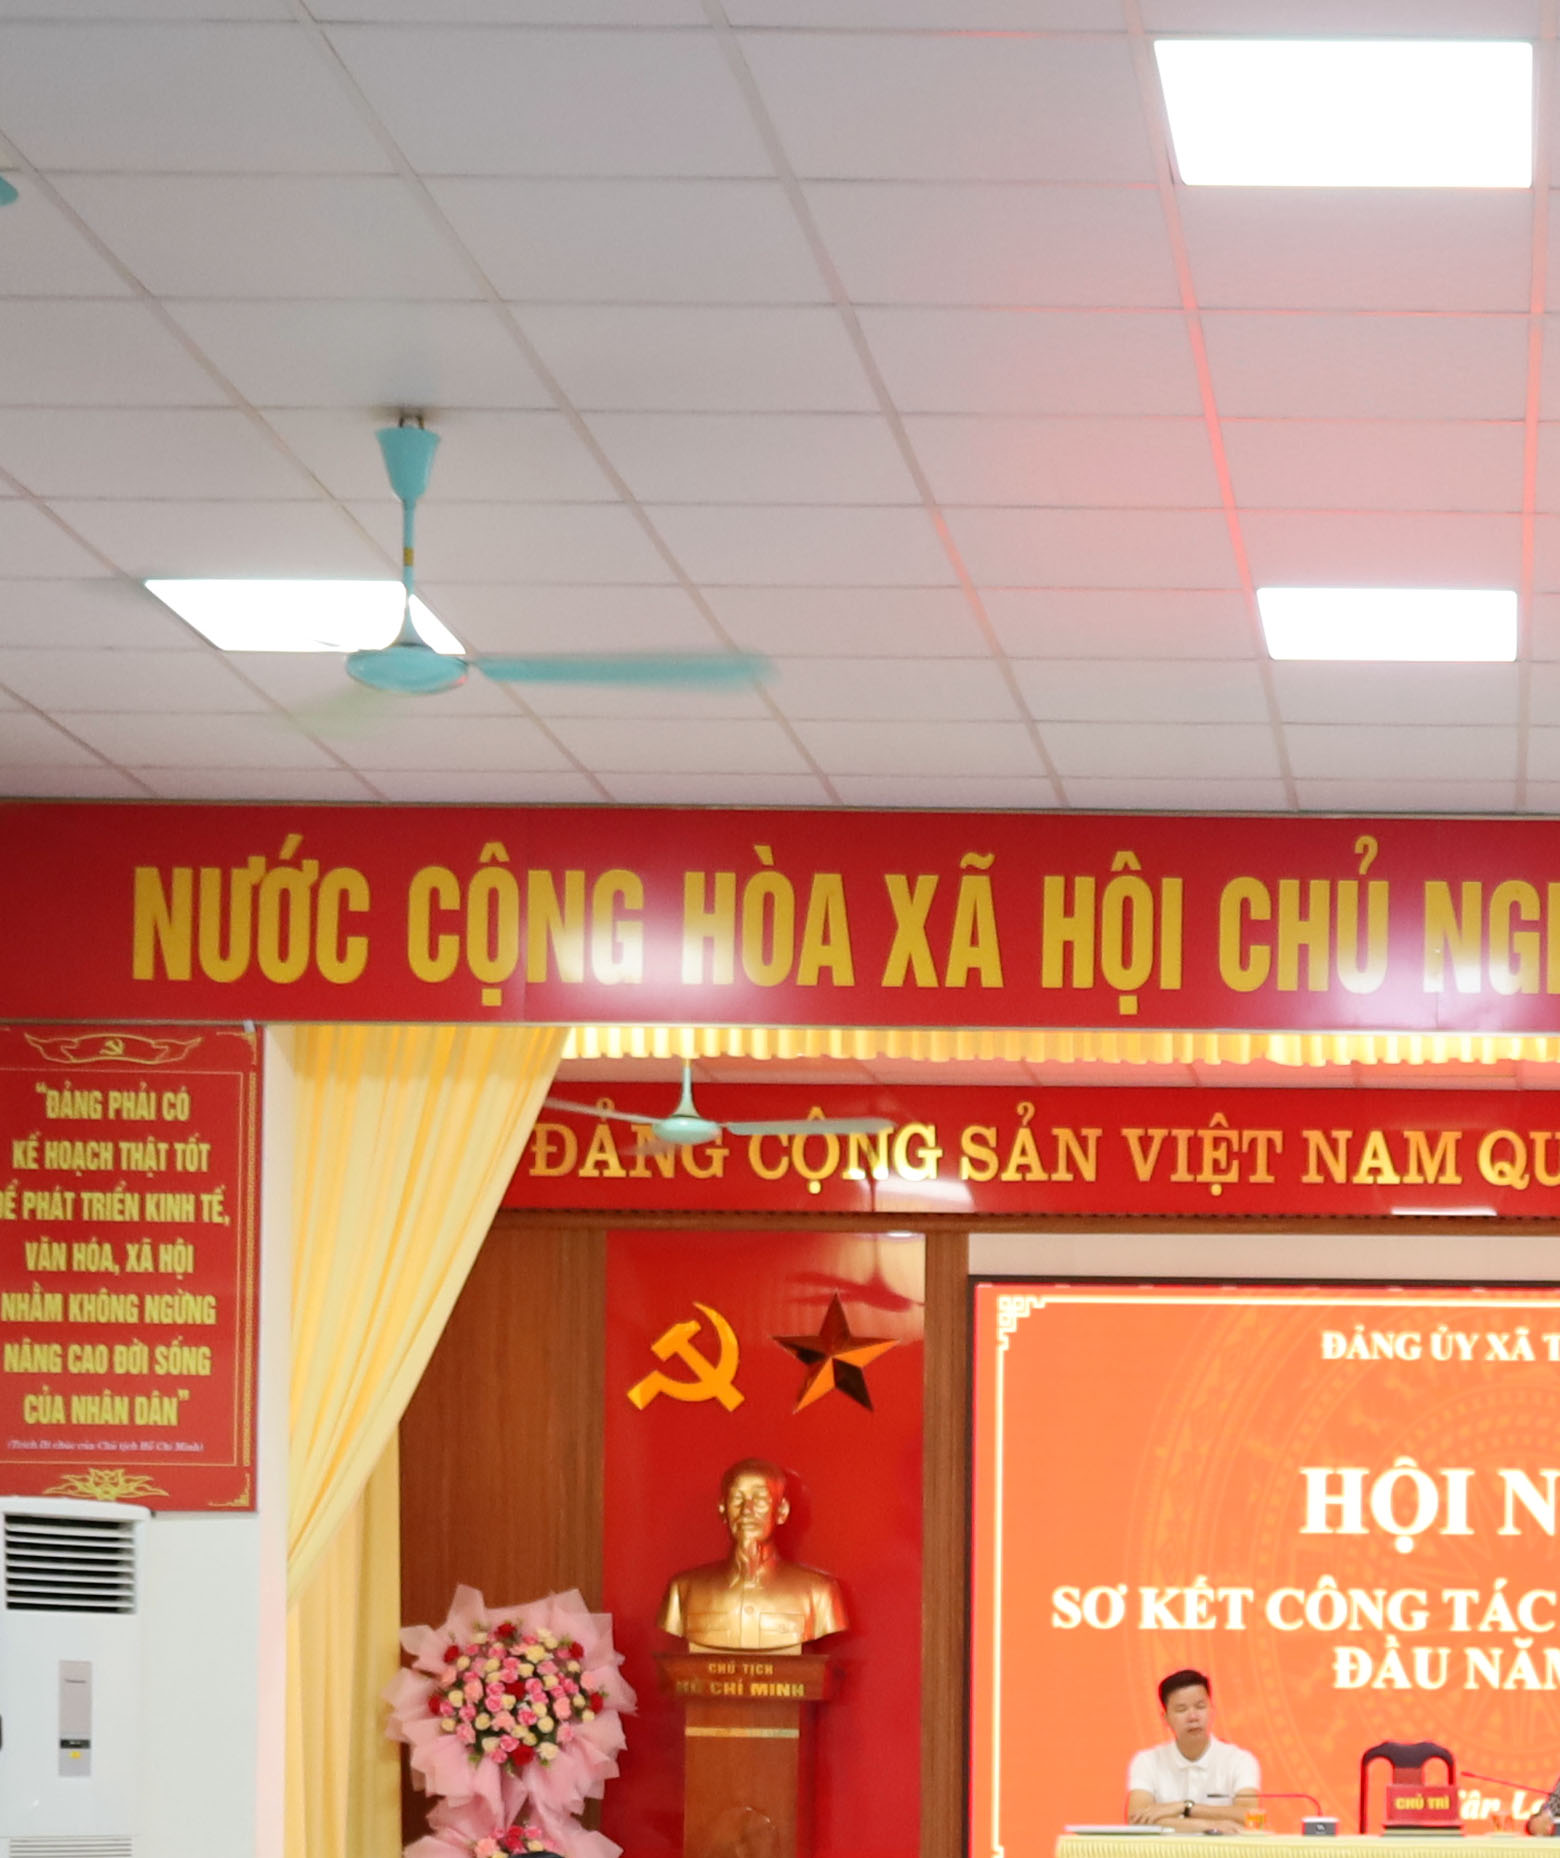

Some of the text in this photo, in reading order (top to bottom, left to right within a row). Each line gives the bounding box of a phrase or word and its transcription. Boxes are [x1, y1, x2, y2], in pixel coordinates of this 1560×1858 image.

[133, 833, 369, 985] NƯỚC
[406, 841, 645, 1006] CỘNG
[682, 841, 854, 989] HÒA
[881, 850, 1004, 991] XÃ
[1039, 848, 1182, 1017] HỘI
[1217, 833, 1391, 993] CHỦ
[36, 1082, 189, 1120] “ĐẢNG PHẢI CÓ
[13, 1135, 210, 1176] KẾ HOẠCH THẬT TỐT
[748, 1107, 943, 1194] CỘNG
[960, 1102, 1103, 1182] SẢN
[1129, 1108, 1282, 1196] VIỆT
[1301, 1128, 1461, 1186] NAM
[23, 1187, 75, 1220] PHÁT
[81, 1182, 140, 1221] TRIỂN
[145, 1193, 195, 1222] KINH
[200, 1186, 230, 1224] TẾ,
[26, 1237, 194, 1279] VĂN HÓA, XÃ HỘI
[1, 1282, 216, 1324] NHẰM KHÔNG NGỪNG
[4, 1336, 211, 1376] NÂNG CAO ĐỜI SỐNG
[1322, 1325, 1422, 1360] ĐẢNG
[1431, 1325, 1479, 1360] ỦY
[1486, 1328, 1534, 1361] XÃ
[23, 1385, 190, 1426] CỦA NHÂN DÂN”
[1300, 1456, 1475, 1553] HỘI
[1053, 1584, 1127, 1629] SƠ
[1139, 1576, 1254, 1629] KẾT
[1266, 1575, 1429, 1631] CÔNG
[1442, 1578, 1556, 1632] TÁC
[1334, 1635, 1450, 1689] ĐẦU
[710, 1678, 743, 1695] CHÍ
[750, 1683, 804, 1697] MINH
